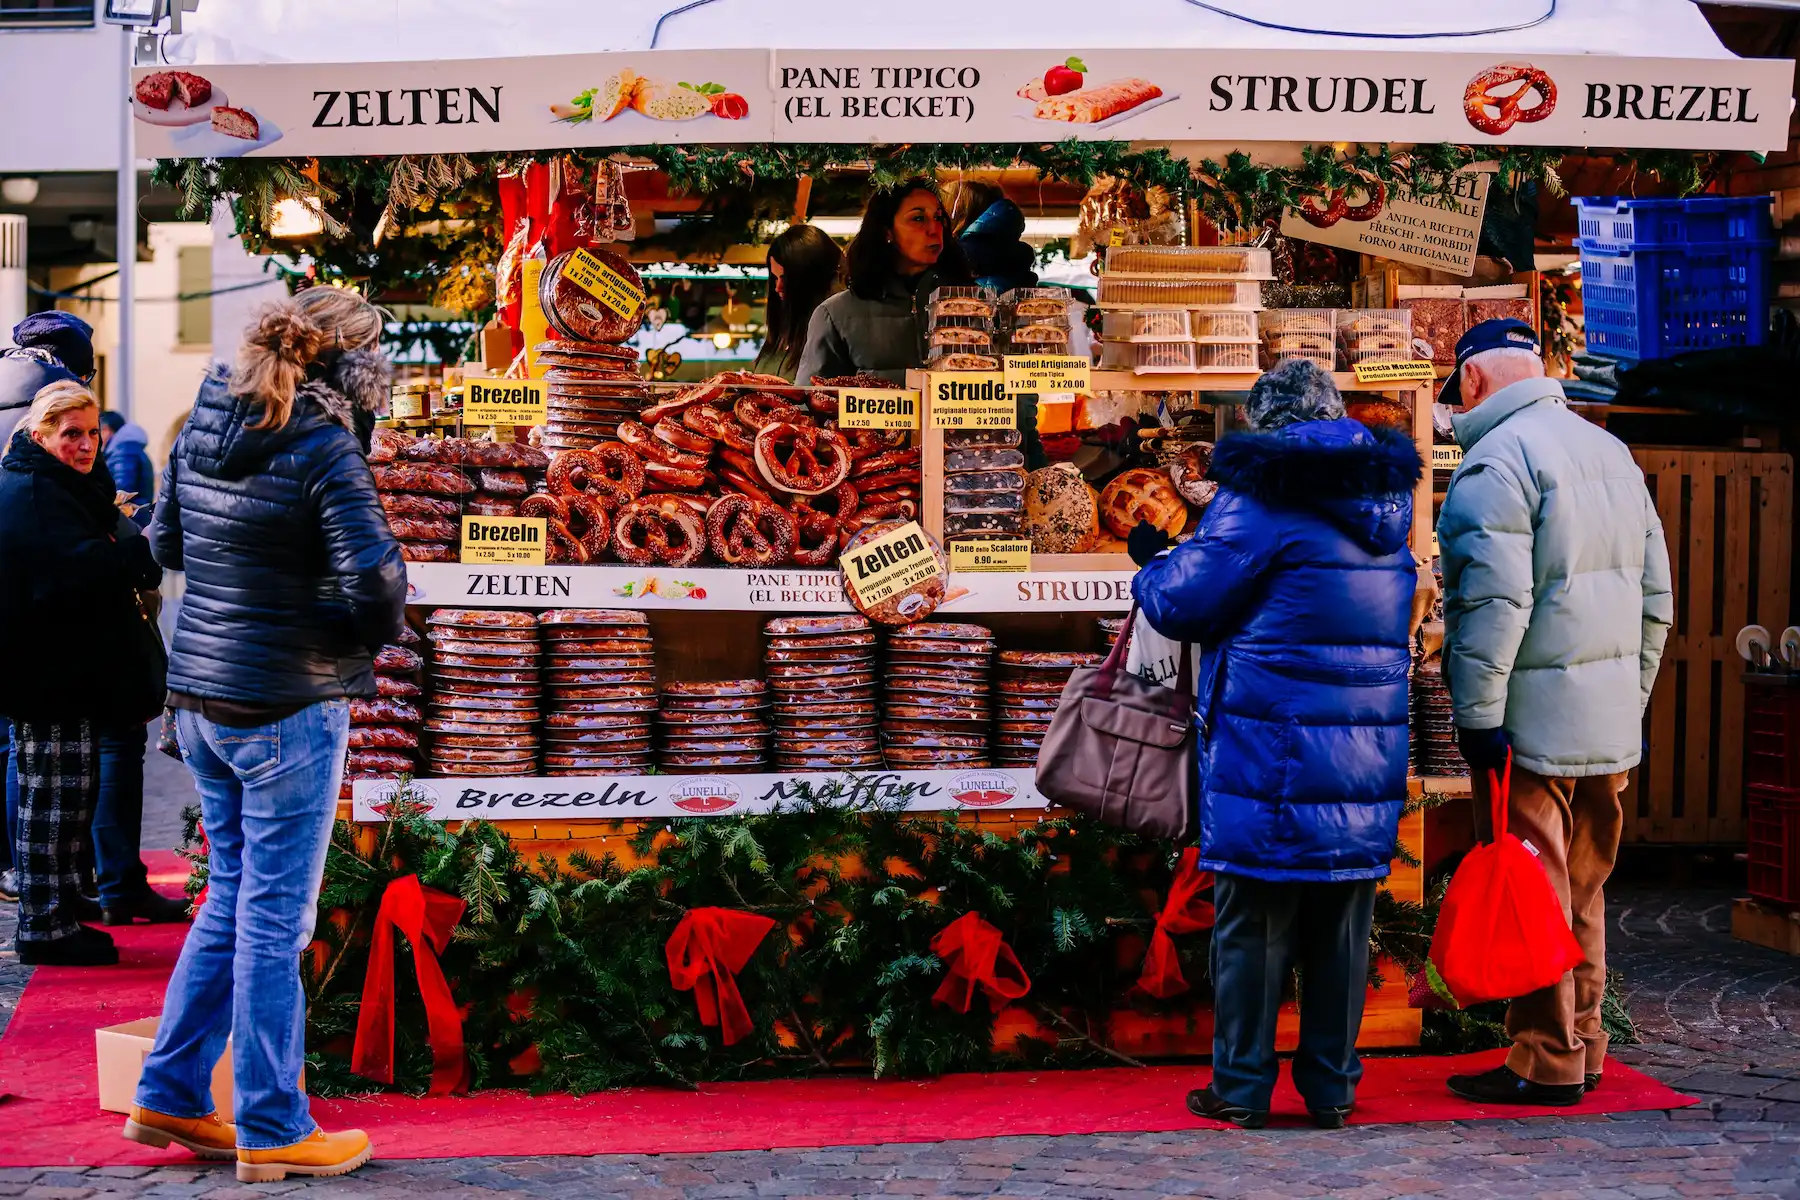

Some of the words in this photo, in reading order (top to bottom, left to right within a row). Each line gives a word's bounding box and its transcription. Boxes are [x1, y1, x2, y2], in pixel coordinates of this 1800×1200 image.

[780, 67, 860, 89] PANE
[870, 67, 981, 89] TIPICO
[1209, 75, 1435, 115] STRUDEL
[1583, 83, 1759, 123] BREZEL
[312, 86, 504, 127] ZELTEN
[784, 96, 832, 122] (EL
[841, 95, 975, 123] BECKET)
[1386, 212, 1426, 228] ANTICA
[1429, 221, 1474, 239] RICETTA
[1369, 222, 1414, 240] FRESCHI
[1423, 234, 1472, 252] MORBIDI
[1358, 234, 1396, 250] FORNO
[1399, 243, 1470, 266] ARTIGIANALE
[576, 251, 600, 272] Zelten
[601, 269, 641, 302] artigianale
[578, 274, 593, 288] 7.90
[601, 290, 607, 298] 3
[612, 298, 631, 315] 20.00
[1008, 360, 1039, 368] Strudel
[1040, 360, 1087, 370] Artigianale
[471, 385, 540, 404] Brezeln
[1010, 380, 1014, 388] 1
[1021, 380, 1037, 388] 7.90
[1050, 380, 1055, 388] 3
[1063, 380, 1085, 388] 20.00
[846, 395, 914, 415] Brezeln
[936, 417, 940, 425] 1
[947, 417, 963, 425] 7.90
[976, 417, 981, 425] 3
[989, 417, 1011, 425] 20.00
[468, 522, 538, 542] Brezeln
[851, 533, 925, 580] Zelten
[955, 544, 974, 553] Pane
[990, 544, 1028, 553] Scalatore
[974, 556, 992, 564] 8.90
[467, 574, 572, 597] ZELTEN
[747, 574, 790, 586] PANE
[796, 574, 842, 587] TIPIC
[859, 575, 892, 595] artigianale
[891, 567, 909, 579] tipico
[908, 555, 934, 570] Trentino
[876, 586, 893, 598] 7.90
[902, 577, 910, 586] 3
[914, 564, 936, 580] 20.00
[749, 590, 775, 604] (EL
[780, 590, 846, 603] BECKET
[1017, 580, 1133, 601] STRUDE
[455, 782, 658, 809] Brezeln
[682, 786, 727, 796] LUNELLI
[960, 780, 1005, 790] LUNELLI
